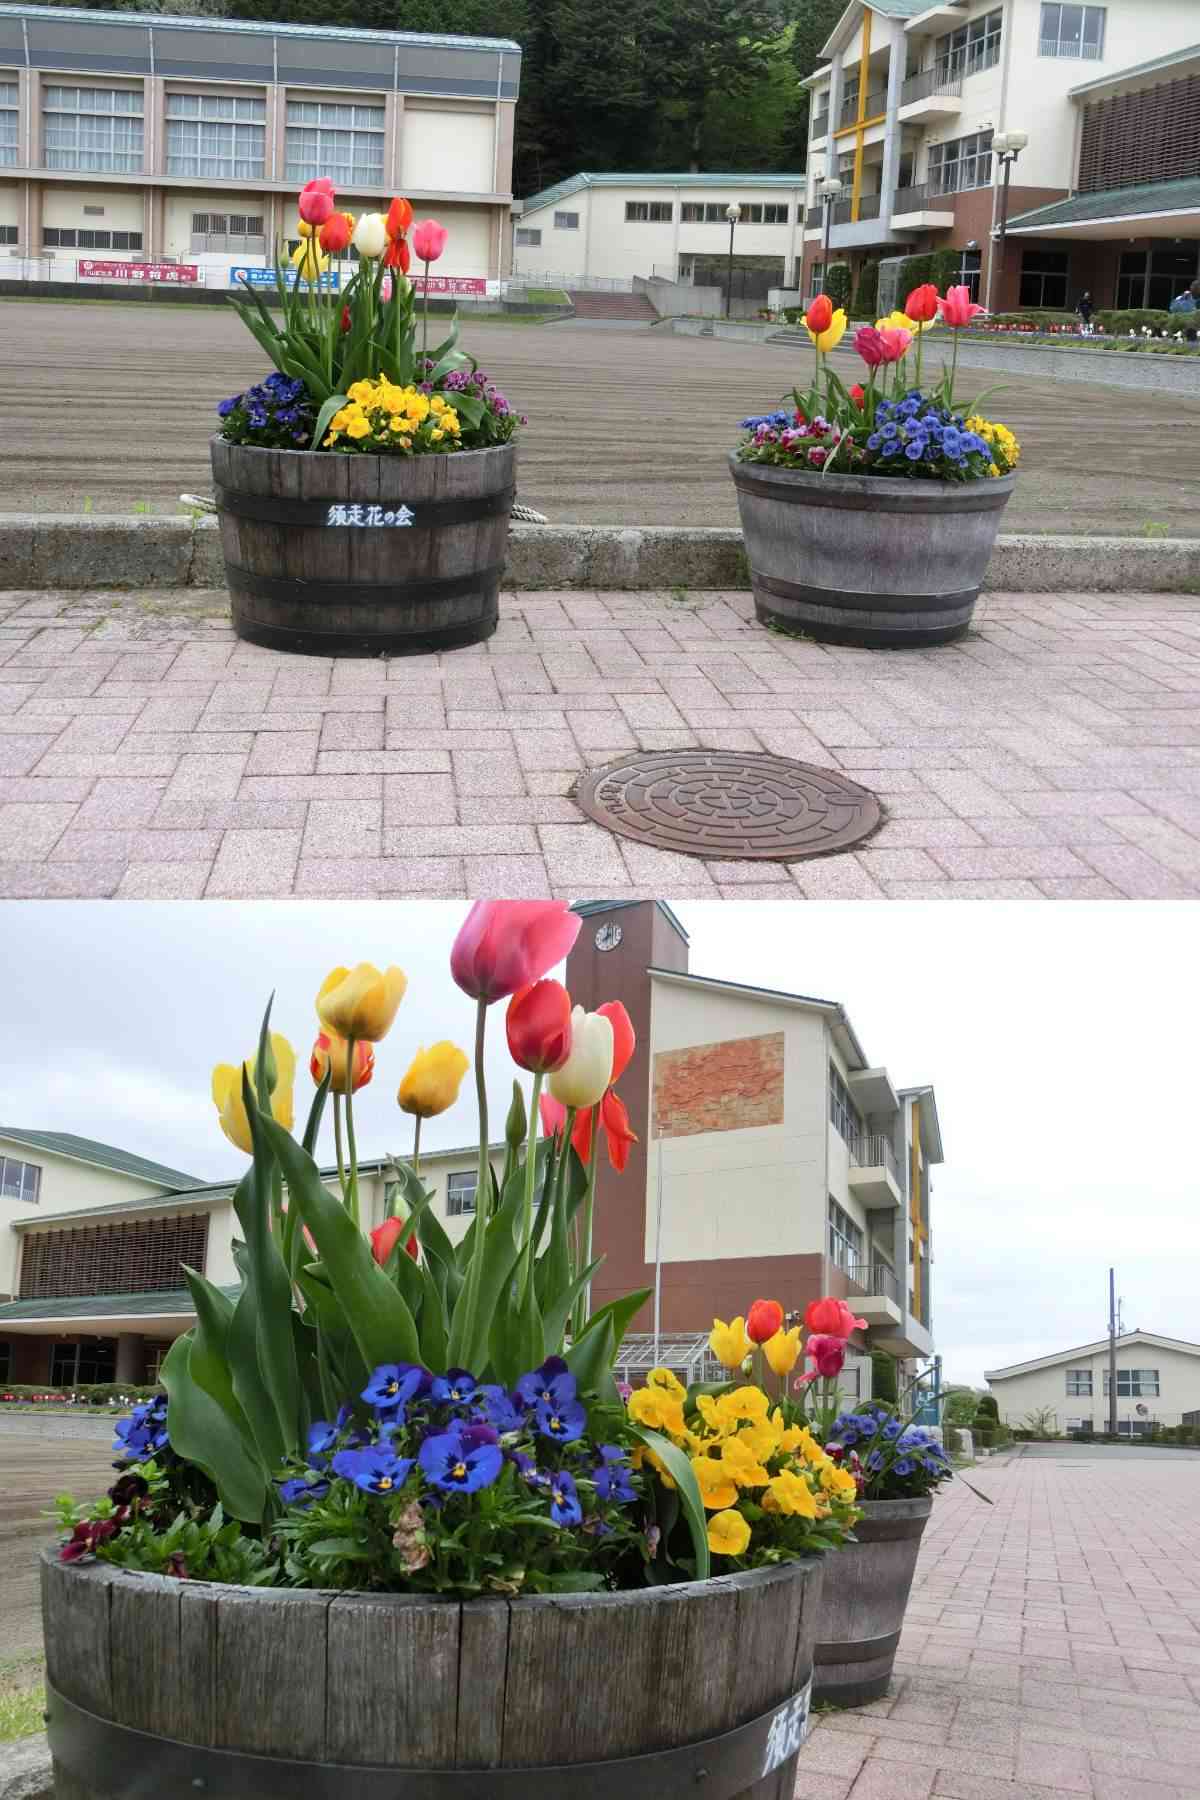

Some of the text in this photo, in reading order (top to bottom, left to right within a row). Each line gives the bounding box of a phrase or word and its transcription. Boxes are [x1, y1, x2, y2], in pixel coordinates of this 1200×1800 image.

[327, 504, 415, 526] 須走花の会
